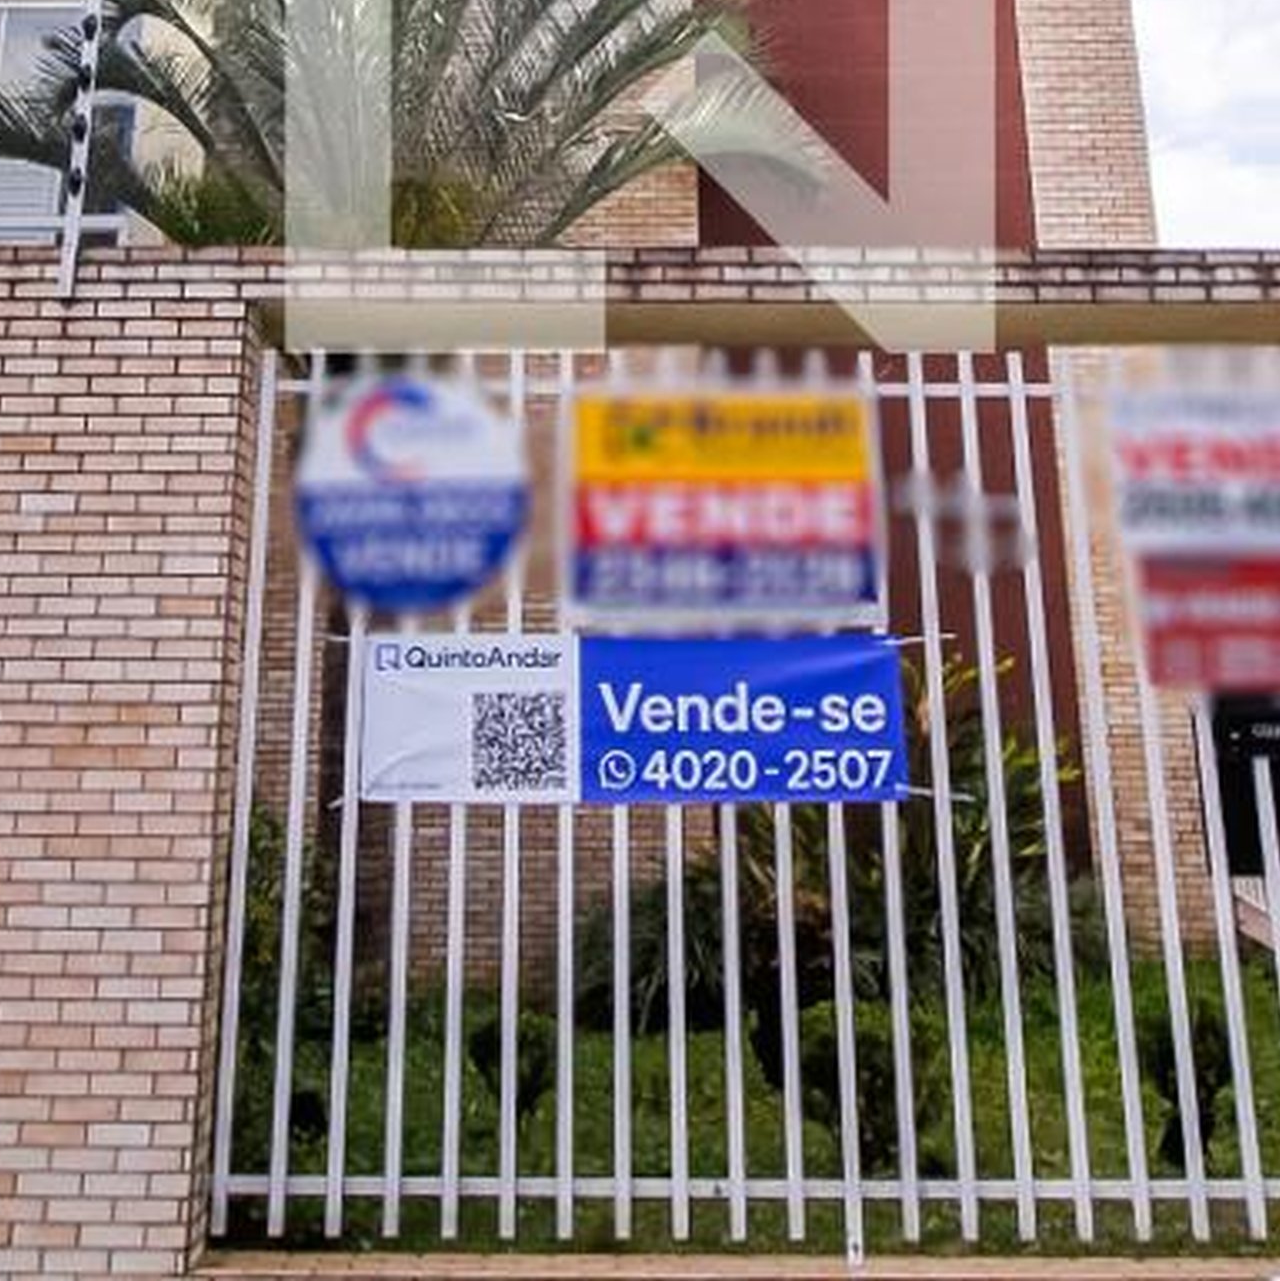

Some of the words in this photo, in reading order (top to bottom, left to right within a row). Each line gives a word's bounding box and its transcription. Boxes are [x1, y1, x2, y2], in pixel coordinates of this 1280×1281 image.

[586, 487, 858, 542] VENDE
[404, 646, 562, 669] QuintoAndar
[597, 680, 888, 734] Vende-se
